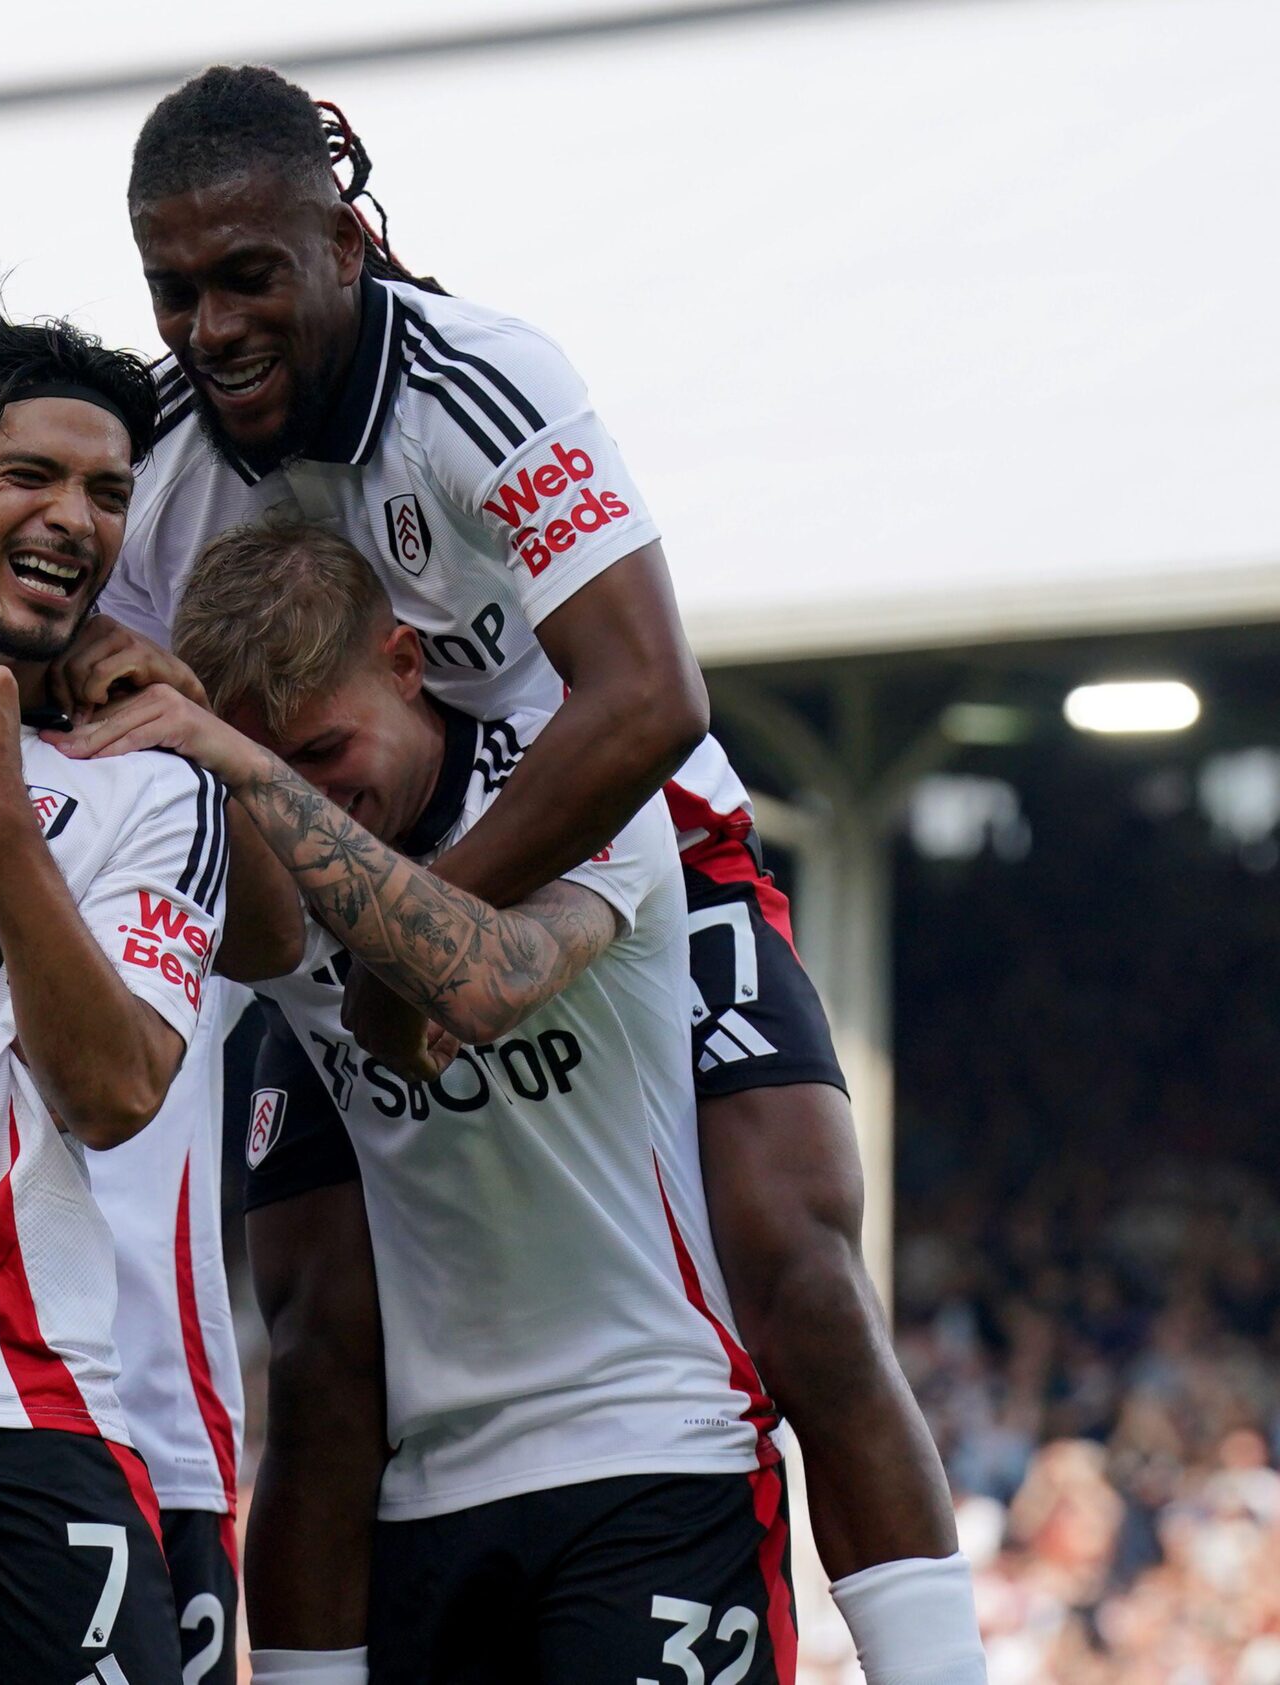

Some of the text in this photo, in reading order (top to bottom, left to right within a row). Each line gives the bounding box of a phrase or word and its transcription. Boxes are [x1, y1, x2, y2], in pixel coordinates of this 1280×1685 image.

[482, 442, 594, 529] Web
[396, 503, 420, 561] FFC
[511, 487, 630, 579] Beds
[117, 924, 203, 1014] Bed
[66, 1522, 129, 1648] 7
[636, 1594, 760, 1685] 32
